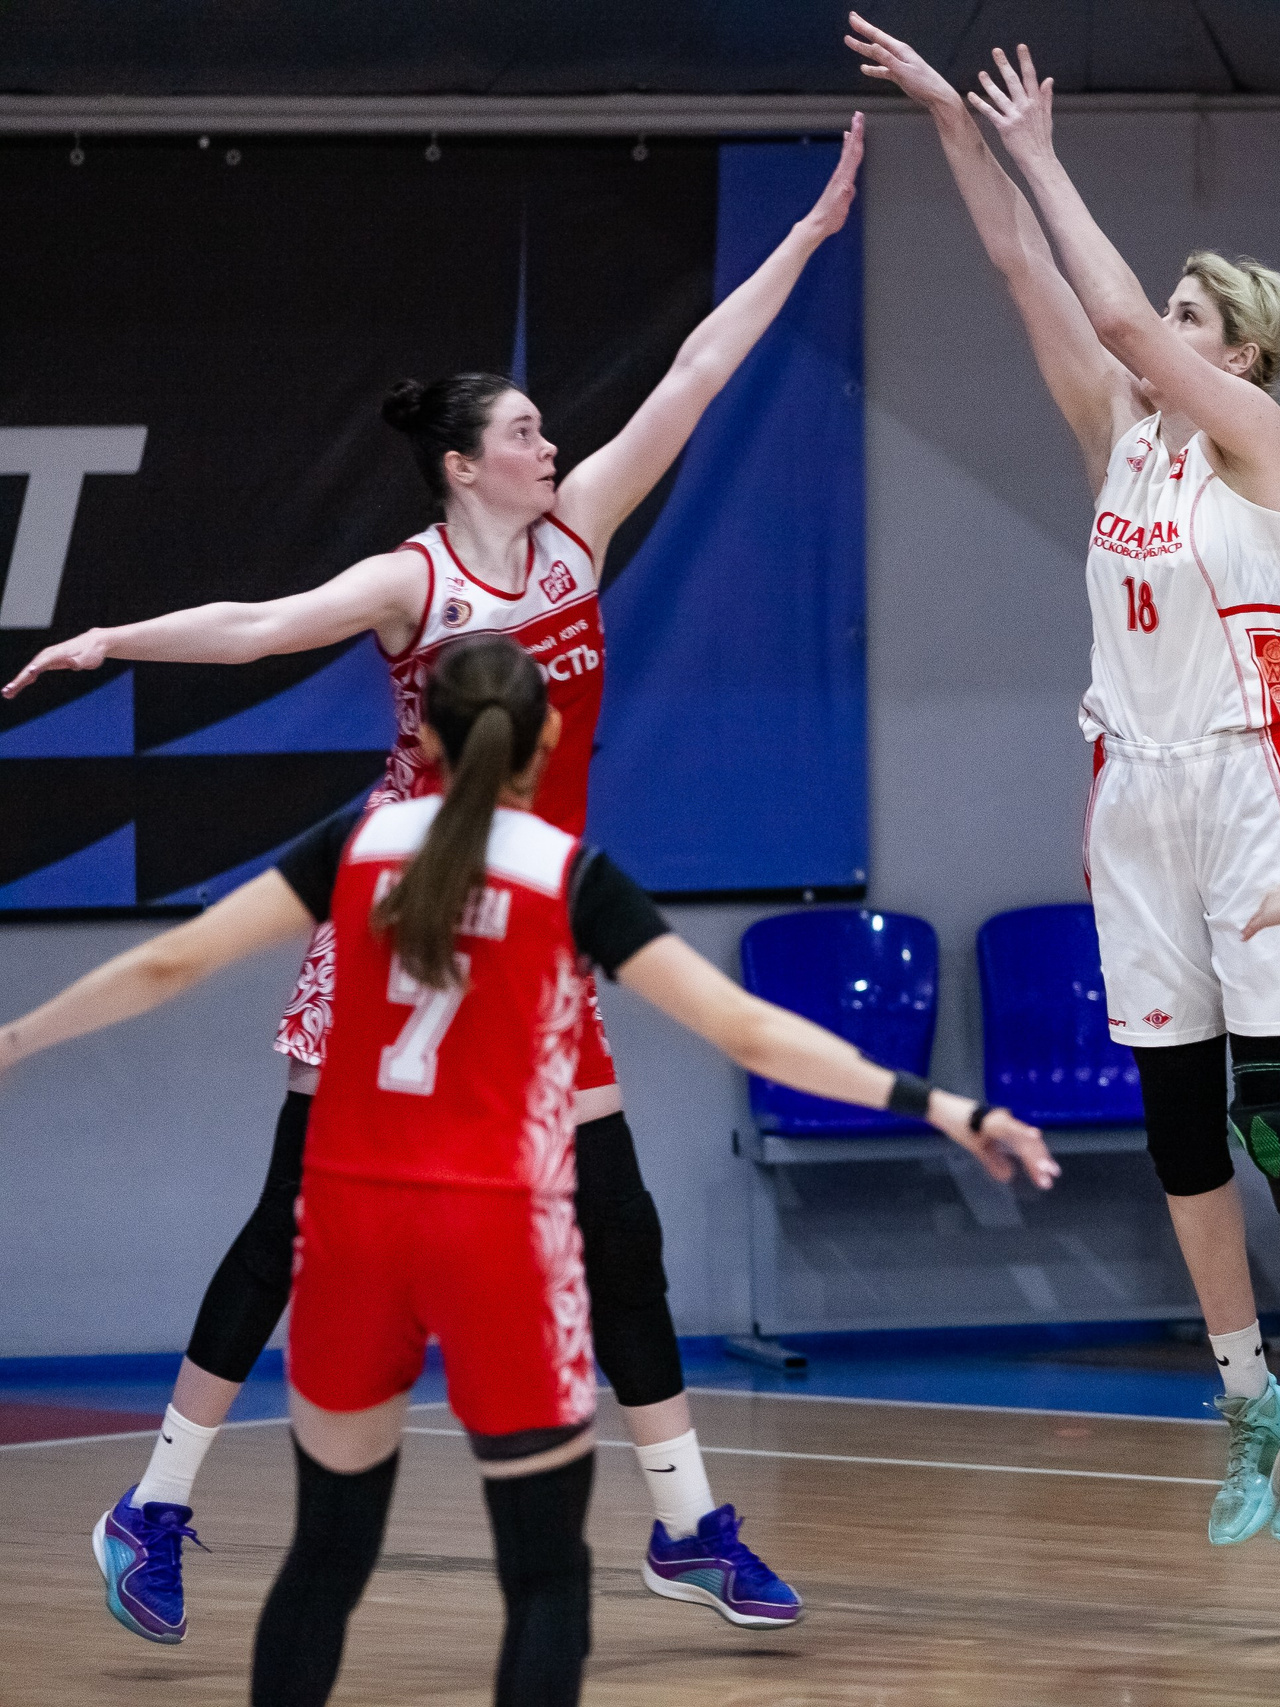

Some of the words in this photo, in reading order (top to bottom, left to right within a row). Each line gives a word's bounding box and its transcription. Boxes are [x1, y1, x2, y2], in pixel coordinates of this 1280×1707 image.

[1096, 511, 1180, 549] СПААК
[1121, 576, 1159, 634] 18
[377, 950, 471, 1096] 7
